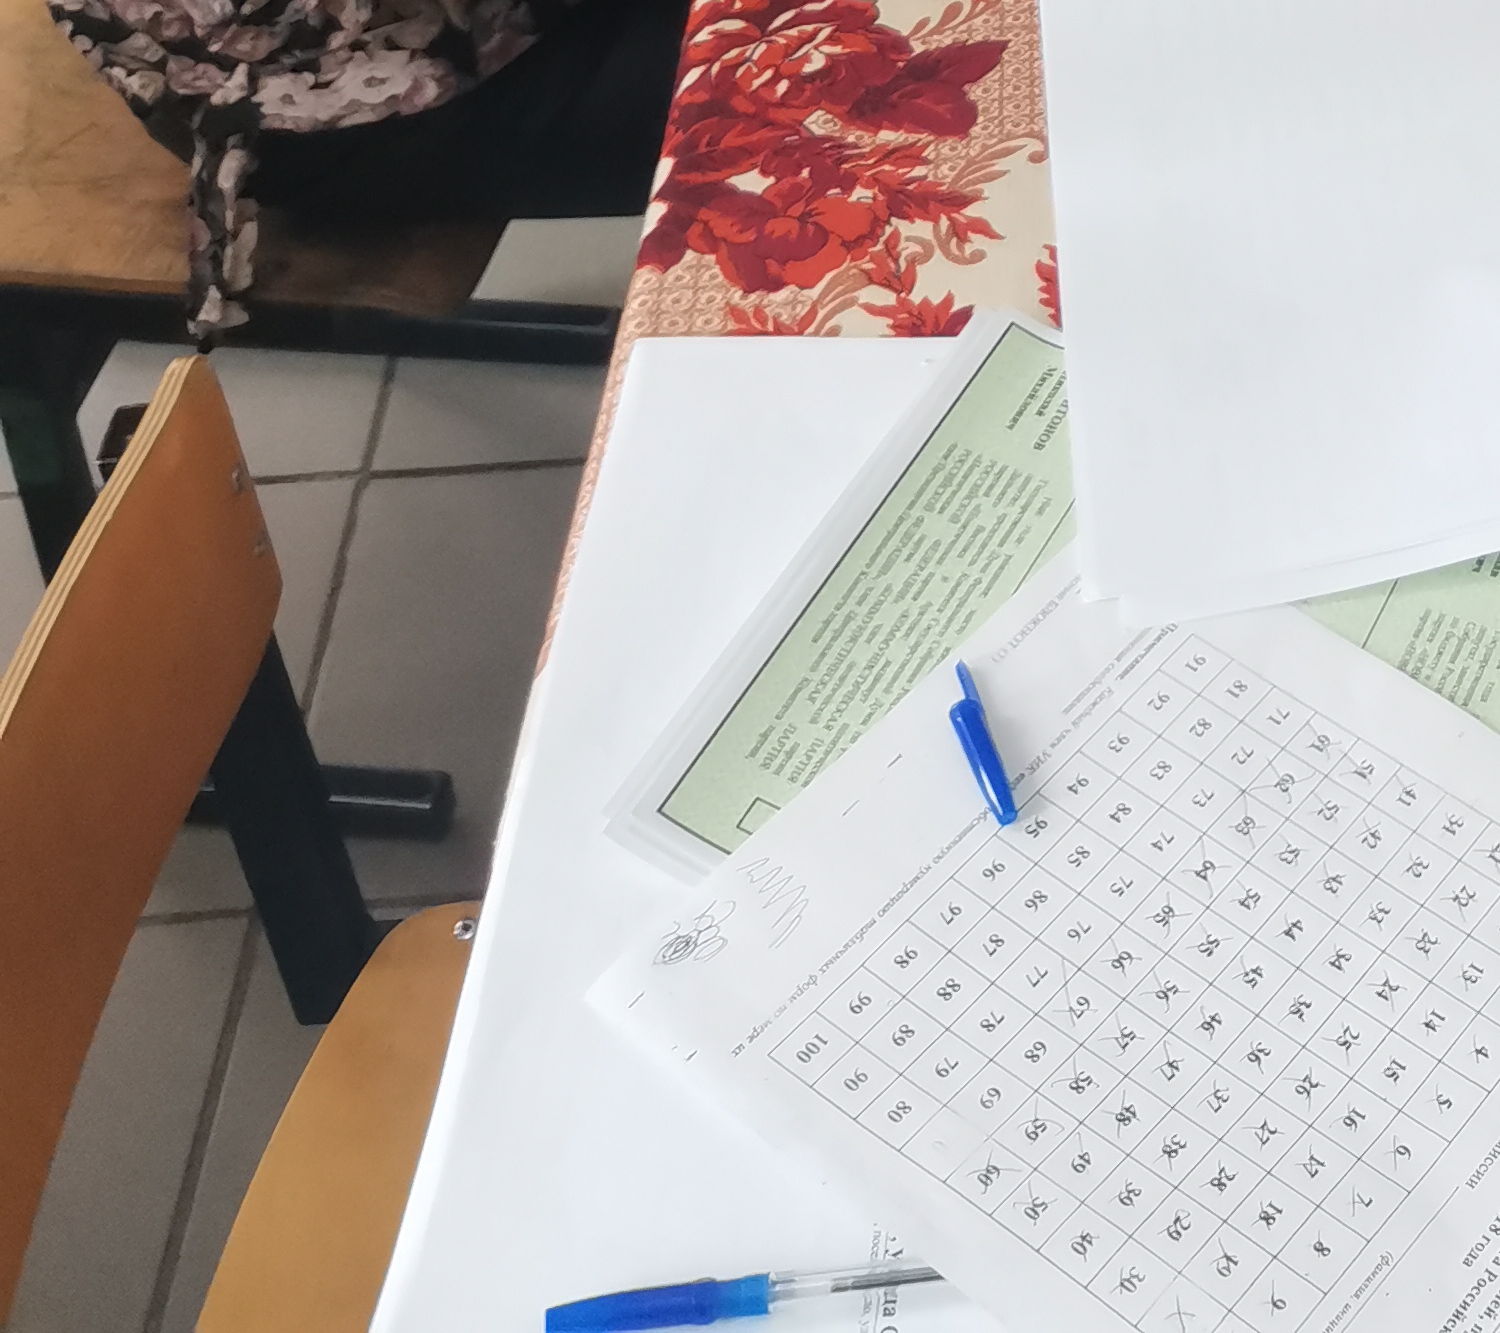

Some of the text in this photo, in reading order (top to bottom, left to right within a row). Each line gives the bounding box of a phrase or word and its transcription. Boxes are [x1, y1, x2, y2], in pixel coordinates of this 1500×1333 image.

[796, 654, 1206, 1063] 91 92 93 94 95 96 97 98 99 100
[844, 680, 1248, 1091] 81 82 83 84 85 86 87 88 89 90
[1452, 886, 1476, 907] 22
[888, 709, 1290, 1122] 71 72 73 74 75 76 77 78 79 80
[980, 734, 1332, 1109] 61 62 63 64 66 67 68 69
[1416, 932, 1438, 954] 23
[1462, 964, 1484, 986] 13
[977, 801, 1339, 1186] 52 54 56 57 58 59 60
[1376, 979, 1400, 1001] 24
[1024, 787, 1416, 1220] 41 42 46 47 48 49 50
[1422, 1010, 1445, 1032] 14
[1071, 815, 1464, 1256] 31 32 33 34 36 37 38 39 40
[1335, 1027, 1359, 1051] 25
[1384, 1059, 1406, 1083] 15
[1296, 1075, 1319, 1099] 26
[1343, 1108, 1366, 1131] 16
[1257, 1122, 1278, 1147] 27
[1303, 1155, 1326, 1178] 17
[1210, 1167, 1237, 1192] 28
[1259, 1203, 1283, 1227] 18
[1166, 1214, 1190, 1241] 29
[1463, 1235, 1491, 1267] года
[1216, 1253, 1238, 1277] 19
[1119, 1267, 1145, 1293] 30
